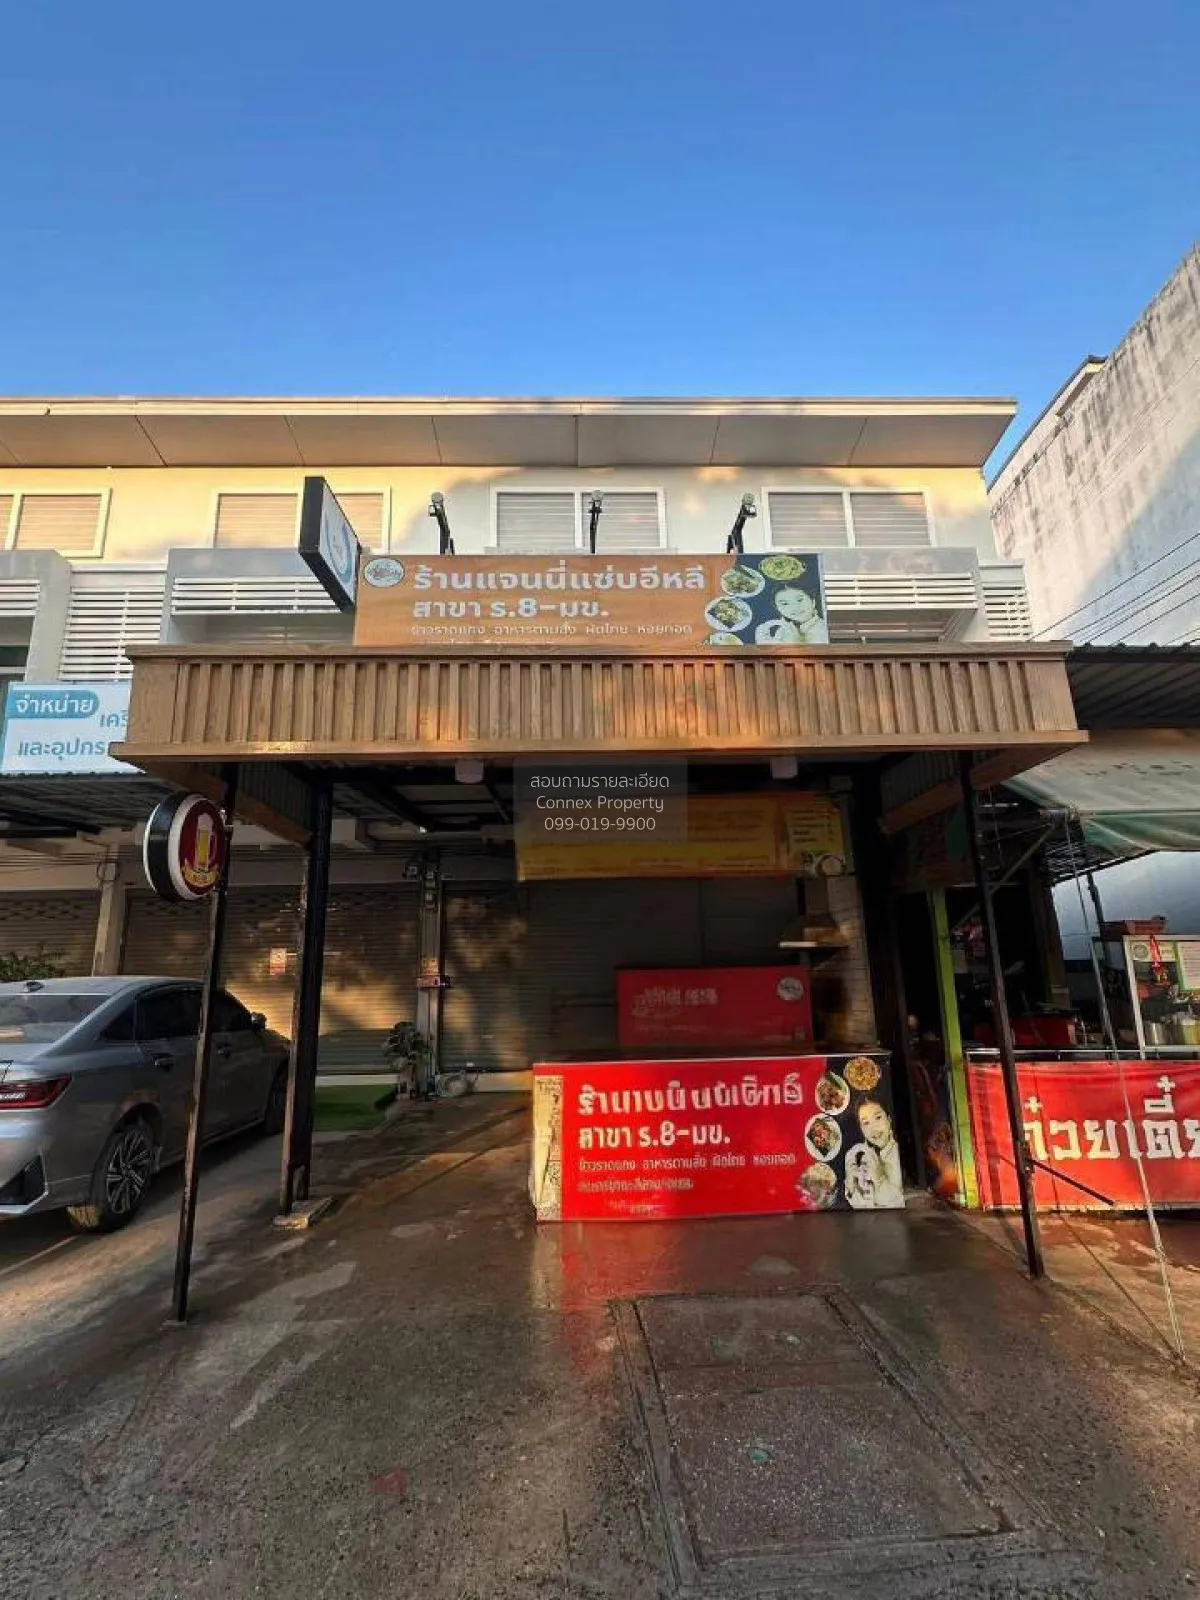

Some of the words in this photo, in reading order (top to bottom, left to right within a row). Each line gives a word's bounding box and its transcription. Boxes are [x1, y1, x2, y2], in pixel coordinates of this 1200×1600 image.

[414, 559, 706, 590] ร้านแจนนี่แซ่บอีหลี
[413, 600, 482, 618] สาขา
[490, 597, 609, 618] ร.8-มข.
[16, 693, 94, 713] จำหน่าย
